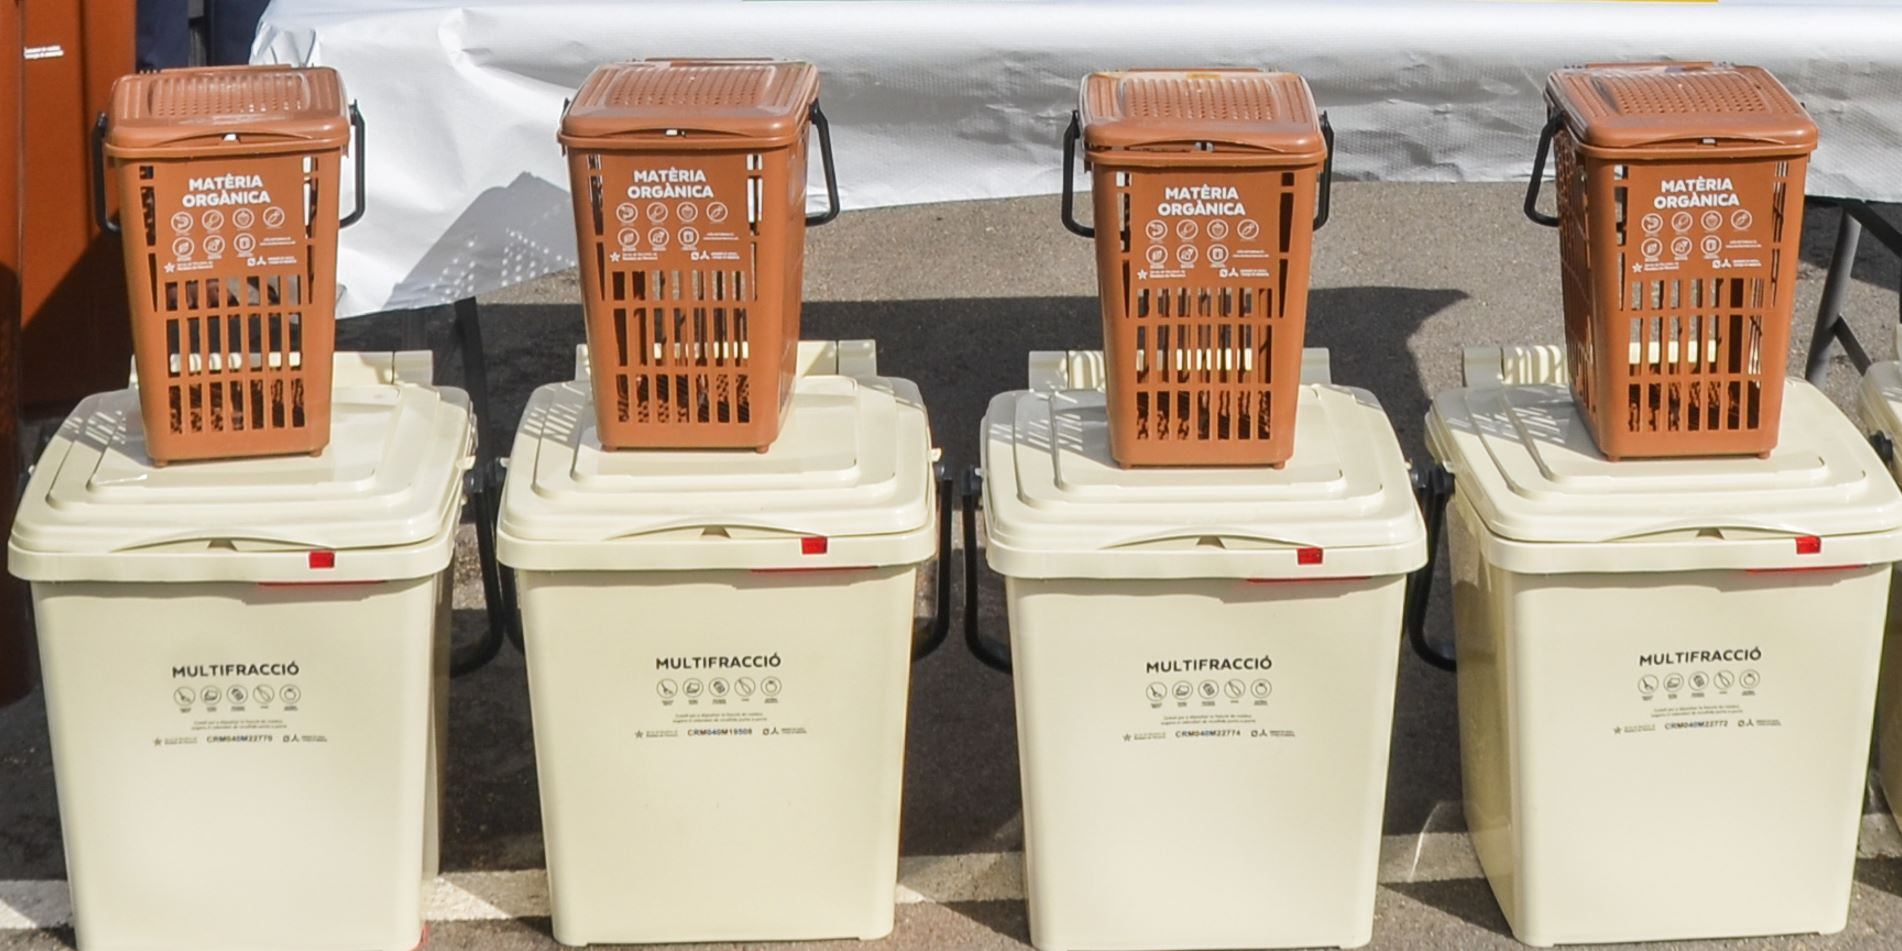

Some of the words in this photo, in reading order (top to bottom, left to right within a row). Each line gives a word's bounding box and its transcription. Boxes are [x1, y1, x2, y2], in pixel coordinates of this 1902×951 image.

[189, 173, 263, 191] MATÈRIA
[634, 166, 706, 182] MATÈRIA
[627, 182, 714, 199] ORGÀNICA
[1165, 184, 1239, 200] MATÈRIA
[1661, 176, 1733, 193] MATÈRIA
[182, 190, 271, 208] ORGÀNICA
[1158, 200, 1246, 216] ORGÀNICA
[1653, 191, 1740, 209] ORGÀNICA
[656, 652, 781, 670] MULTIFRACCIÓ
[1146, 655, 1272, 673] MULTIFRACCIÓ
[1639, 646, 1762, 666] MULTIFRACCIÓ
[172, 660, 300, 678] MULTIFRACCIÓ
